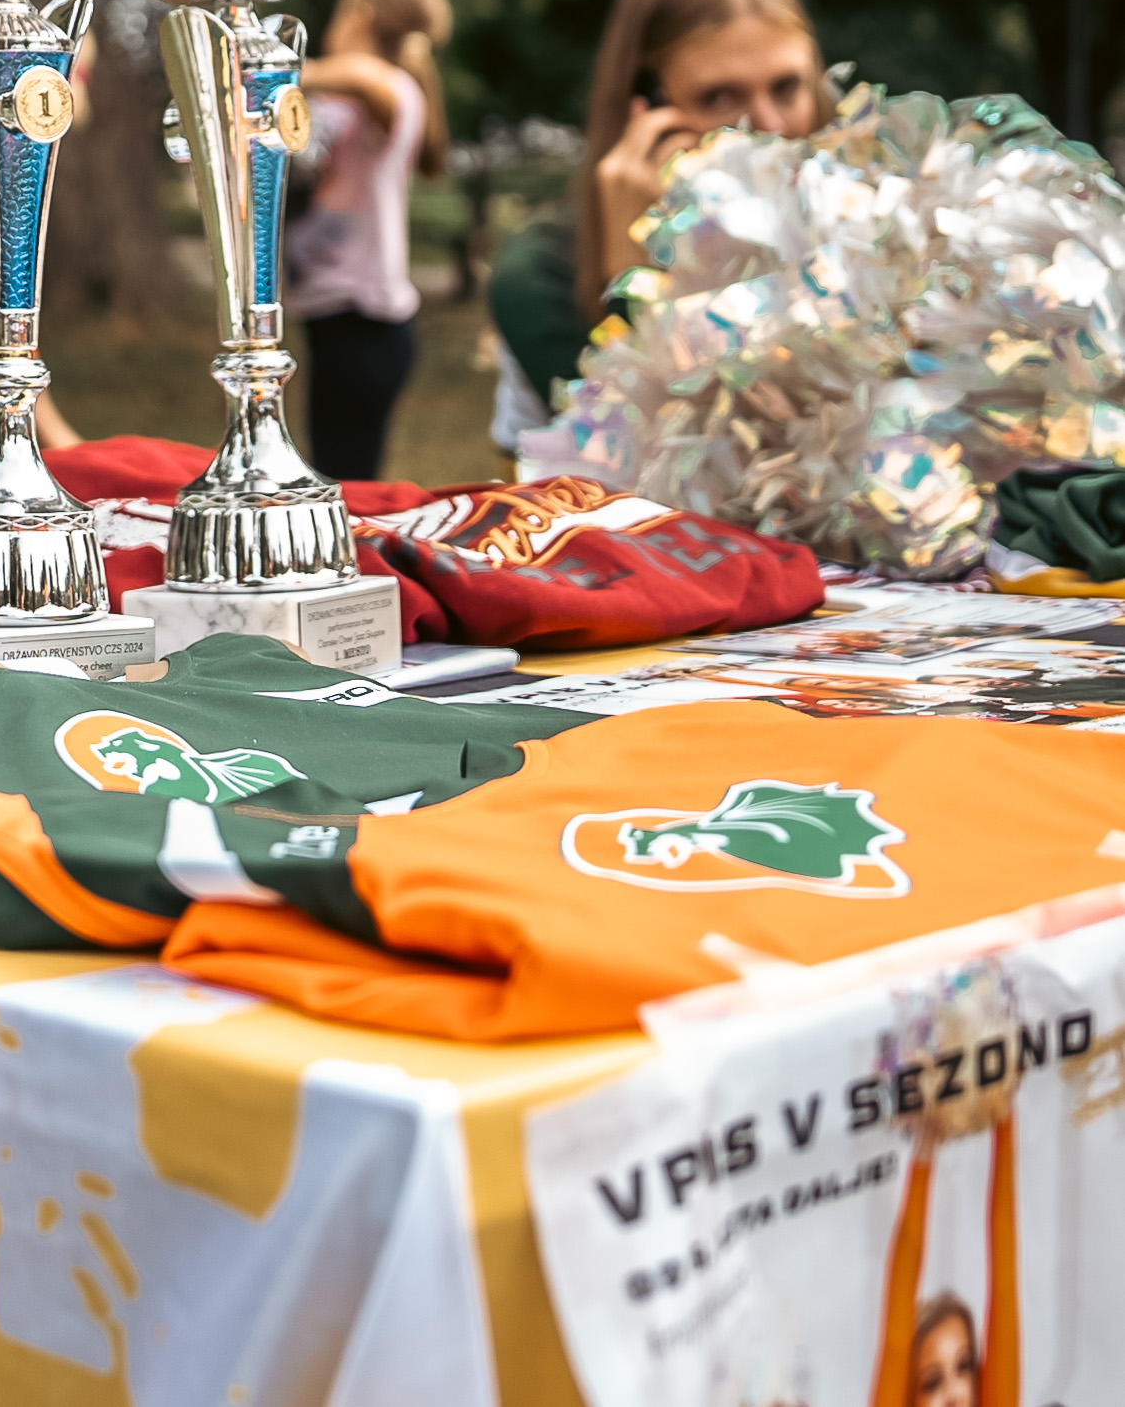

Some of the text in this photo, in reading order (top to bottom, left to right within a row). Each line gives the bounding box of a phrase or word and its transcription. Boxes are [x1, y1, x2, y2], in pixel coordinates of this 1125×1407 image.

[49, 645, 103, 658] PRVENSTVO
[104, 643, 123, 655] CZS
[124, 642, 144, 654] 2024
[90, 661, 113, 672] cheer
[595, 1116, 759, 1225] VPIS
[846, 1011, 1093, 1132] SEZONO
